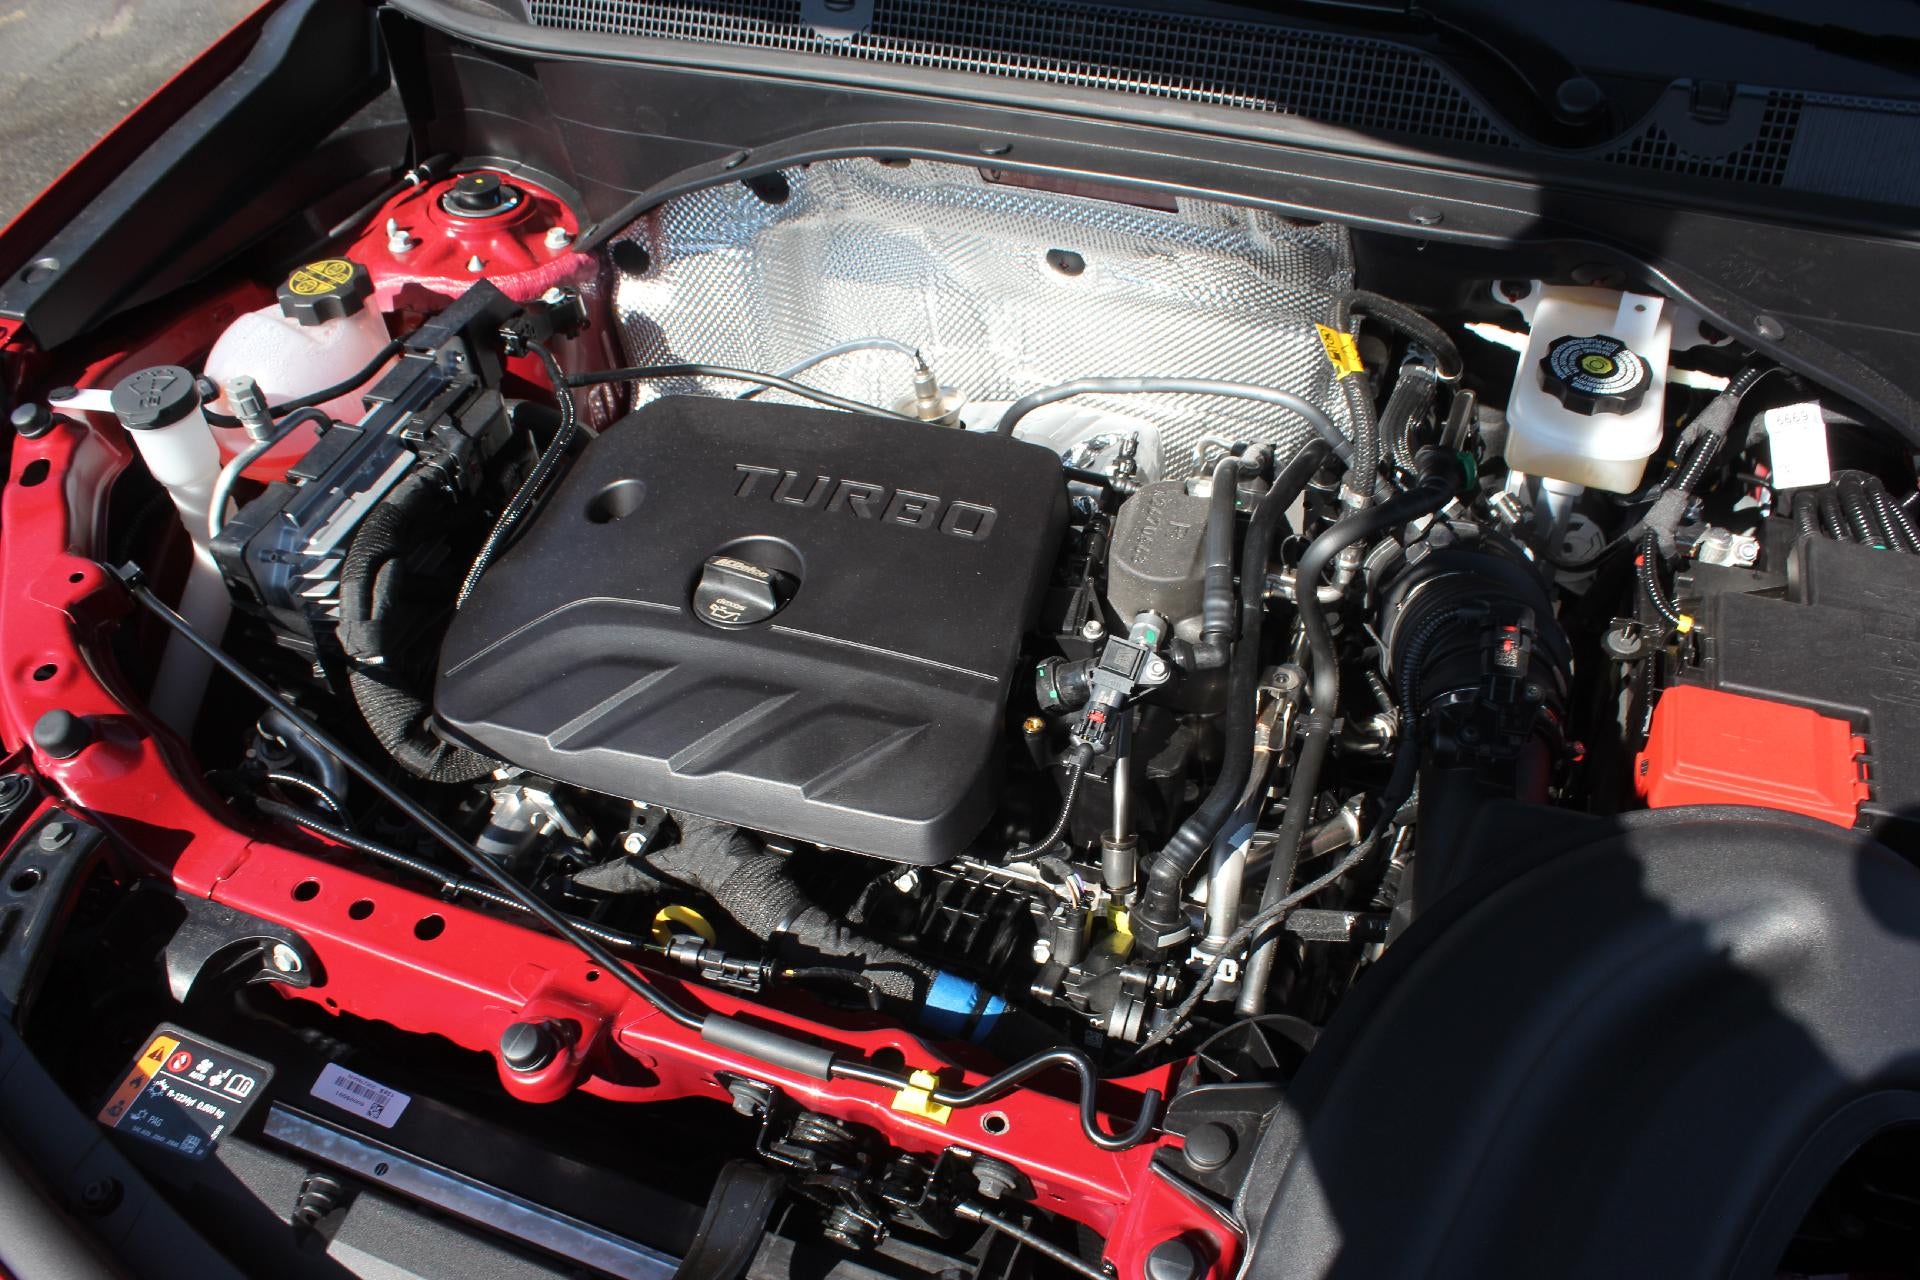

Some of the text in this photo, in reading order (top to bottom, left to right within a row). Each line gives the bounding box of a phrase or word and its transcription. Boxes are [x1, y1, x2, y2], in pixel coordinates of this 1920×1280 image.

[734, 463, 998, 542] TURBO
[713, 558, 770, 578] ACDelco
[188, 1070, 207, 1082] AUTO
[147, 1115, 164, 1127] PAG
